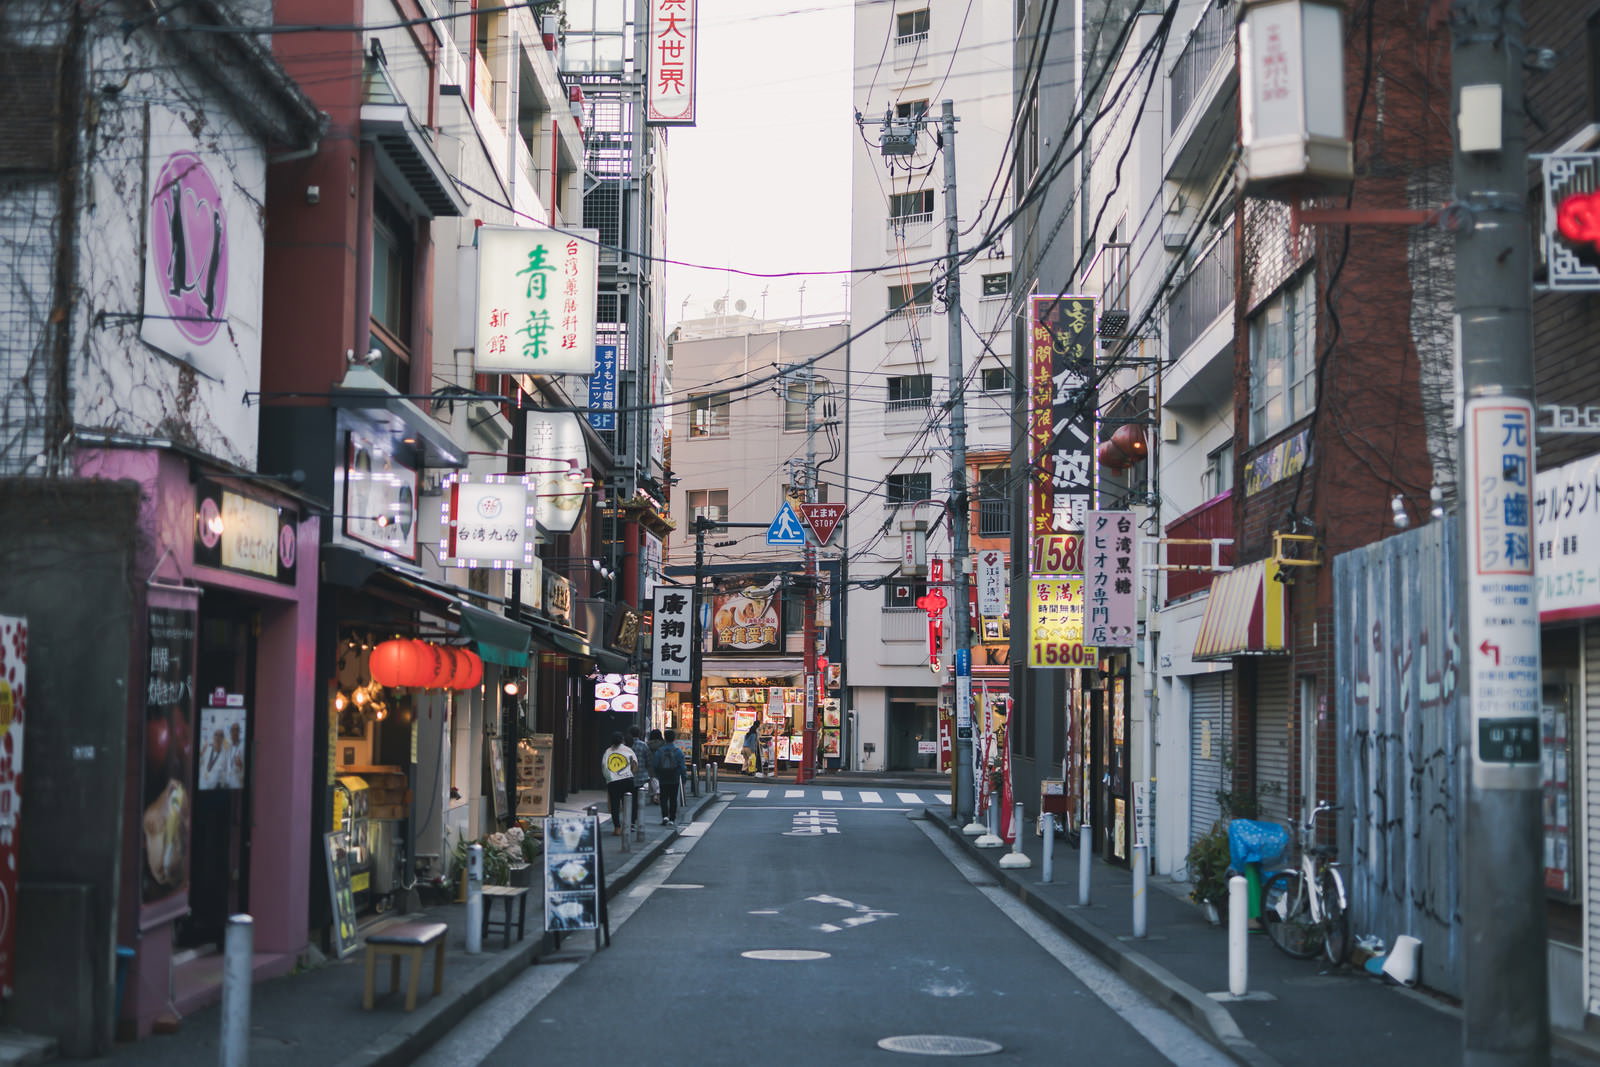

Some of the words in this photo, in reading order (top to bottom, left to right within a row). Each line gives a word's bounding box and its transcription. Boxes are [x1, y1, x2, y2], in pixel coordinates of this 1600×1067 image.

[515, 244, 556, 359] 青葉
[592, 414, 611, 427] 3F
[1502, 413, 1530, 568] 元町歯科
[809, 508, 838, 518] 止まれ
[814, 519, 834, 528] STOP
[1481, 477, 1500, 569] クリニック
[458, 527, 519, 542] 台湾九份
[1114, 516, 1132, 595] 台湾黒糖
[1038, 604, 1084, 614] 時間無制
[1038, 615, 1084, 625] オーダー
[658, 593, 688, 664] 廣翔記
[719, 626, 778, 645] 金賞受賞
[1034, 626, 1084, 641] 食べ放
